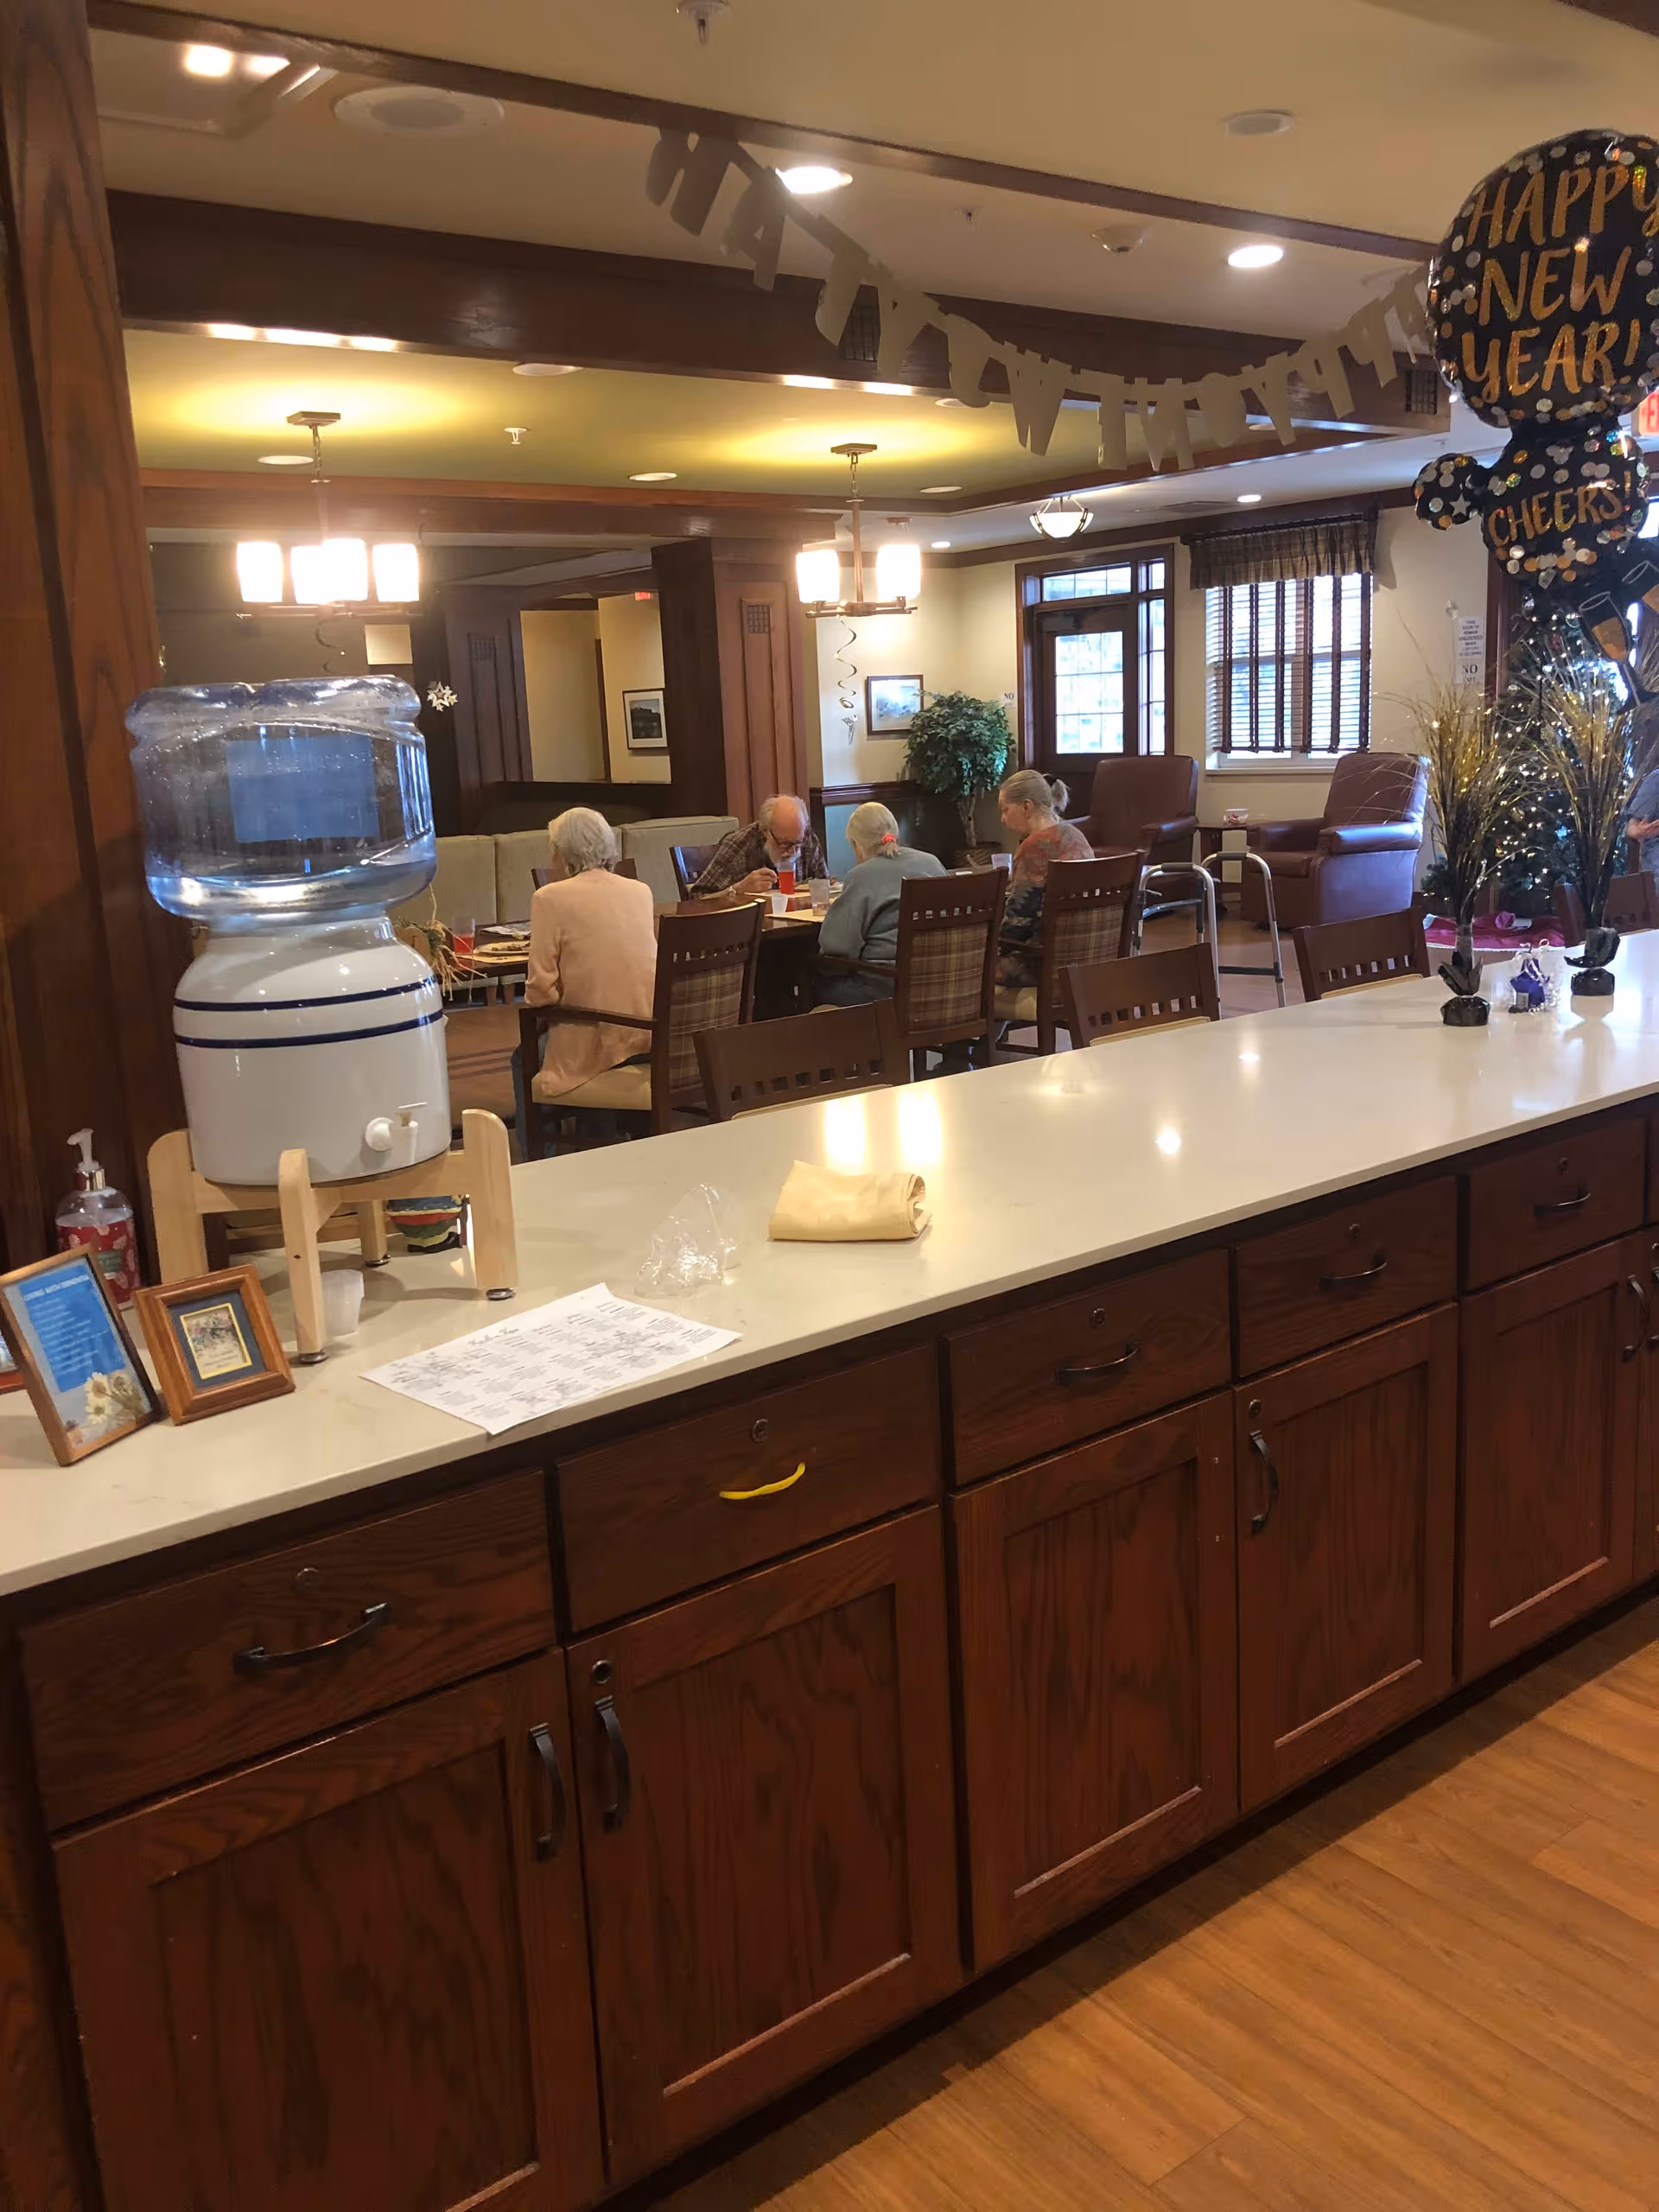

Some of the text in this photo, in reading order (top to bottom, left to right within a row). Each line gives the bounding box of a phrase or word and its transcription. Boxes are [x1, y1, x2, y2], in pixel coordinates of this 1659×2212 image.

[1478, 237, 1632, 326] NEW
[1462, 318, 1640, 404] YEAR!
[1489, 471, 1631, 547] CHEERS!
[1462, 664, 1478, 674] NO
